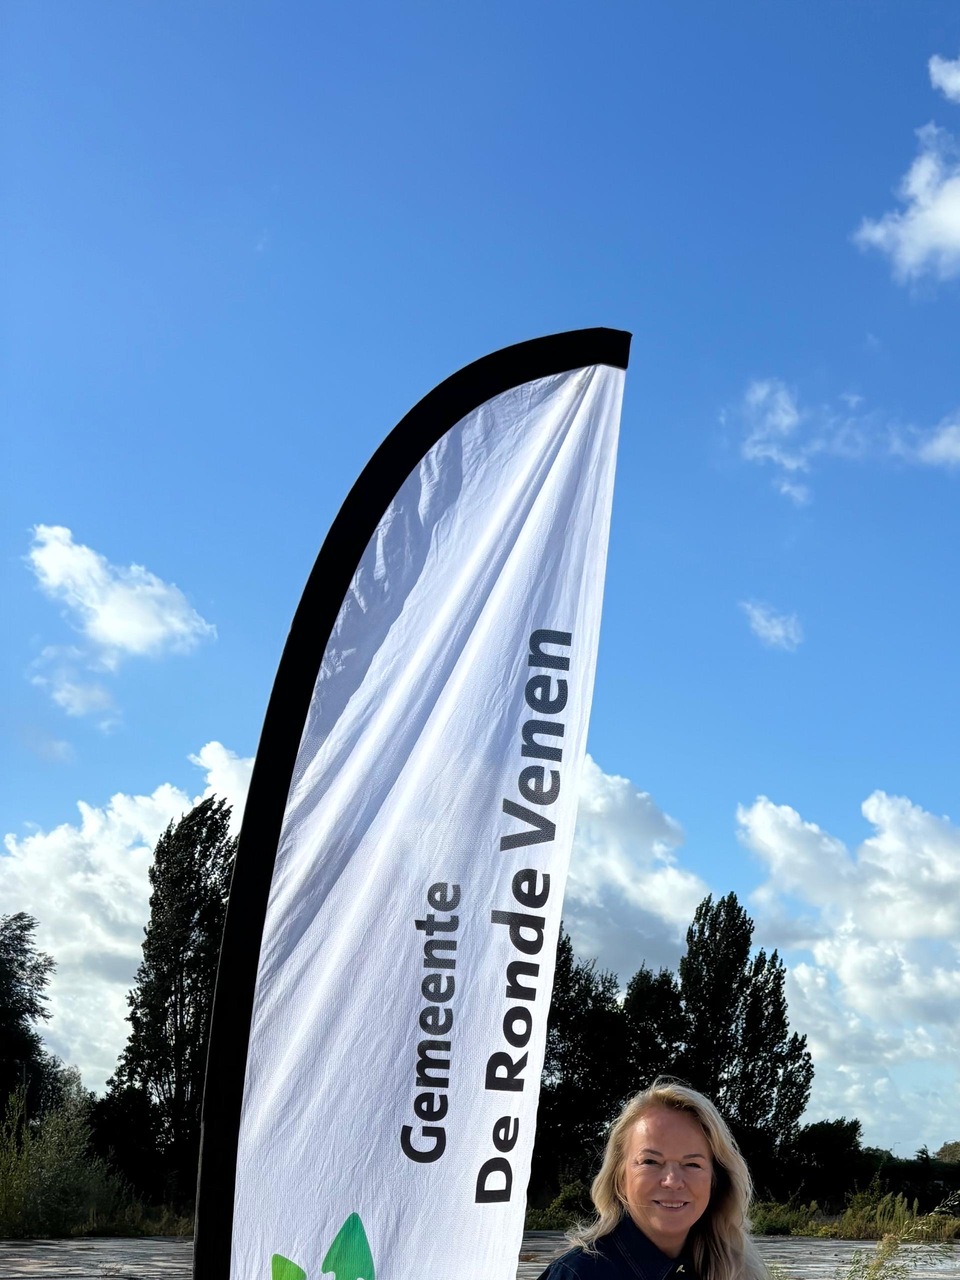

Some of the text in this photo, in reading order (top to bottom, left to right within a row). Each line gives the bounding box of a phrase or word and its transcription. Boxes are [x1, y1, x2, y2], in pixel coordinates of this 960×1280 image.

[401, 881, 461, 1164] Gemeente
[475, 627, 572, 1204] De Ronde Venen
